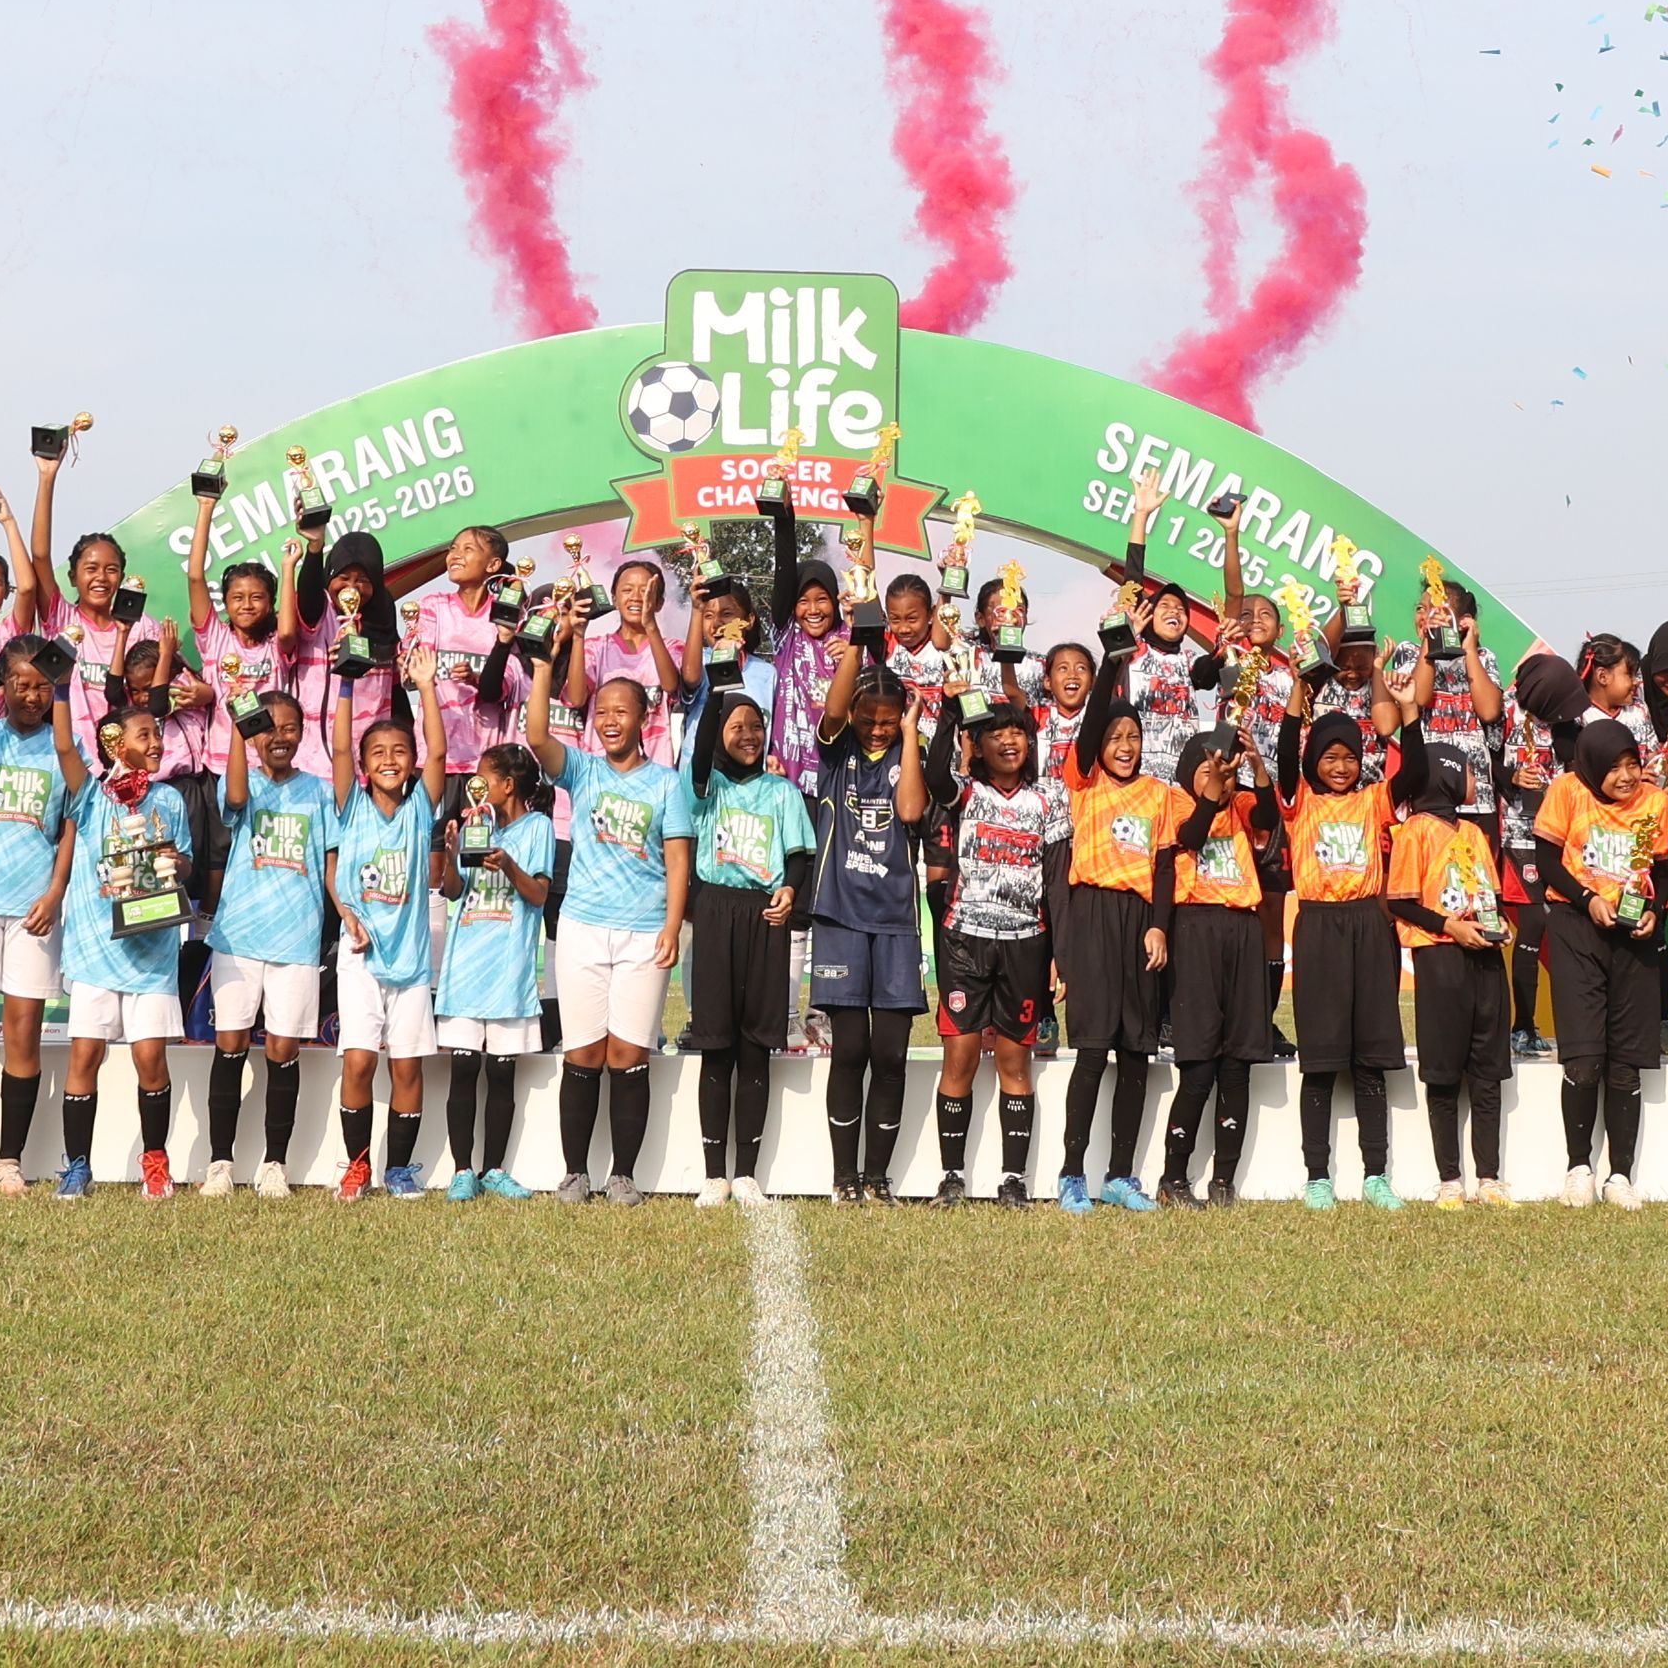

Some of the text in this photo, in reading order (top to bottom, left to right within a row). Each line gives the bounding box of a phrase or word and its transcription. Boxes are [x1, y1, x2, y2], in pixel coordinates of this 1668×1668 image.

[692, 287, 878, 370] Milk
[721, 368, 883, 450] Life
[720, 459, 832, 483] SOCCER
[314, 466, 475, 553] 025-2026
[697, 485, 851, 510] CHAENG
[1096, 422, 1384, 604] SEMARANG
[1168, 515, 1187, 545] 1
[3, 791, 44, 816] Life
[601, 796, 646, 827] Milk
[260, 815, 303, 839] Milk
[265, 836, 304, 861] Life
[380, 873, 406, 896] Lif
[1019, 999, 1035, 1023] 3
